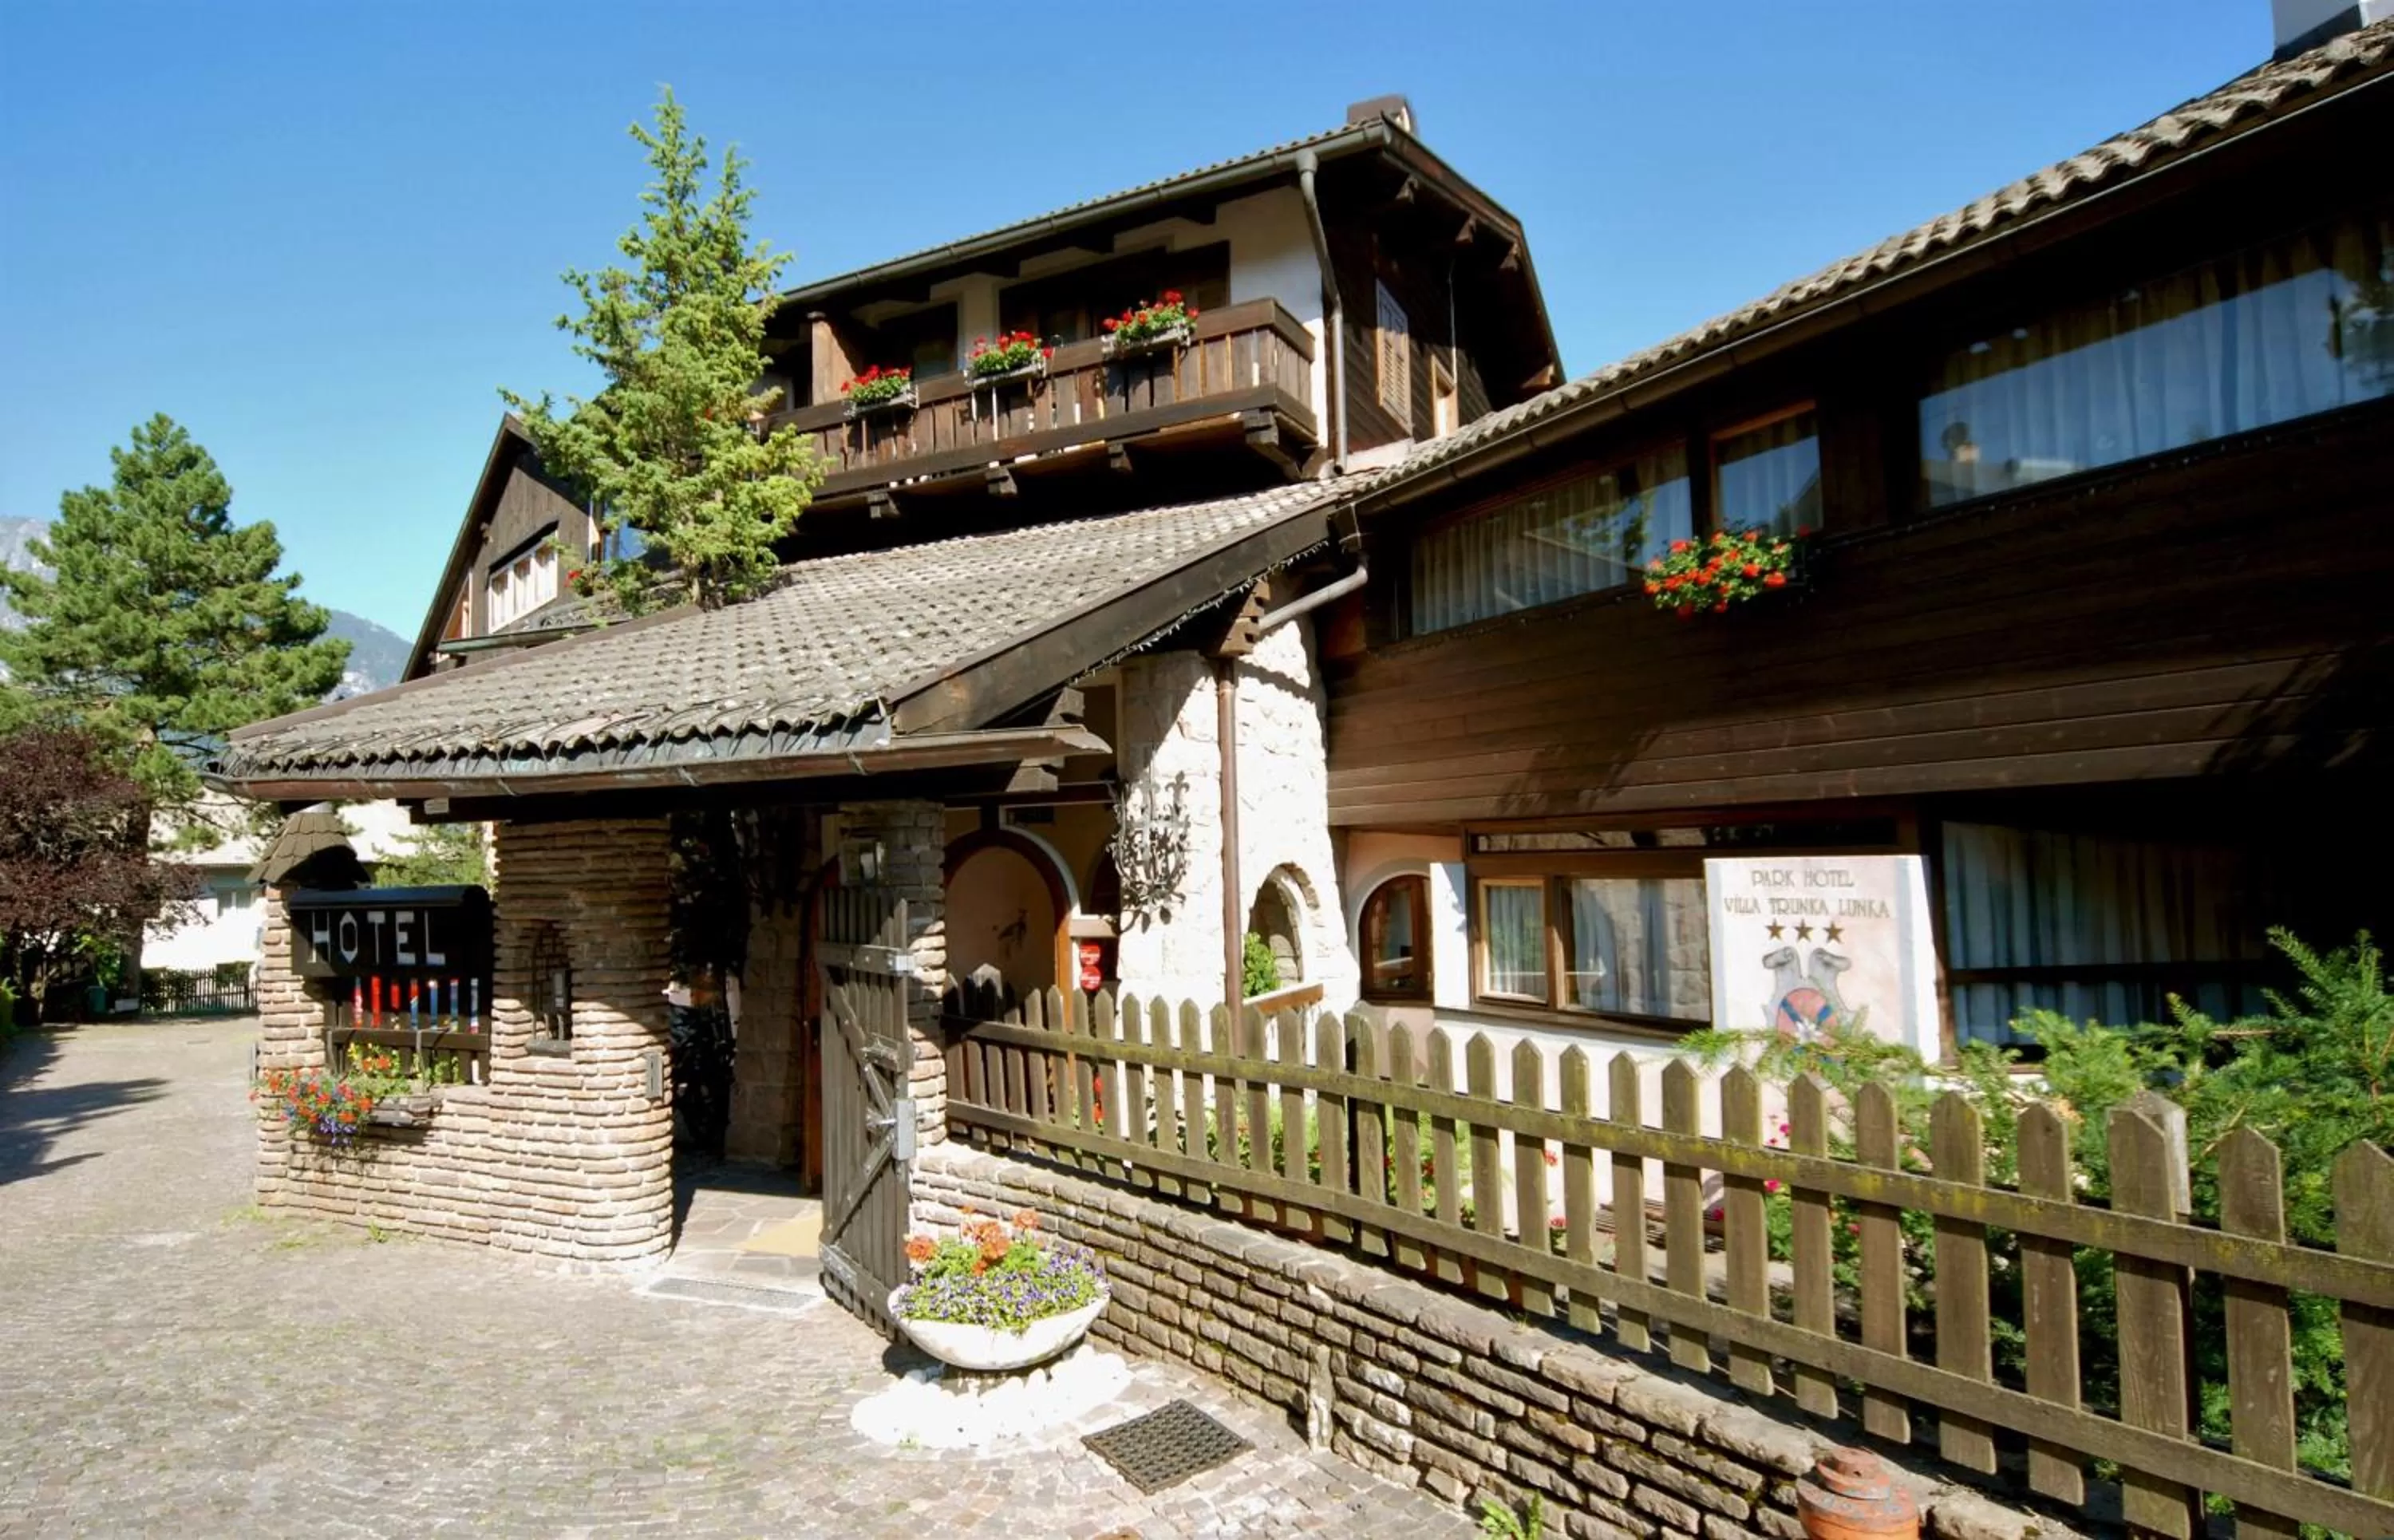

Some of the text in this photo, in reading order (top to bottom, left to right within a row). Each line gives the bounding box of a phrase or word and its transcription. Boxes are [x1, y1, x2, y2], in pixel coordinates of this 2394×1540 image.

[1752, 869, 1855, 888] PARK HOTEL
[1724, 894, 1890, 918] VILLA TRUNKA LUNKA
[311, 910, 446, 965] HOTEL
